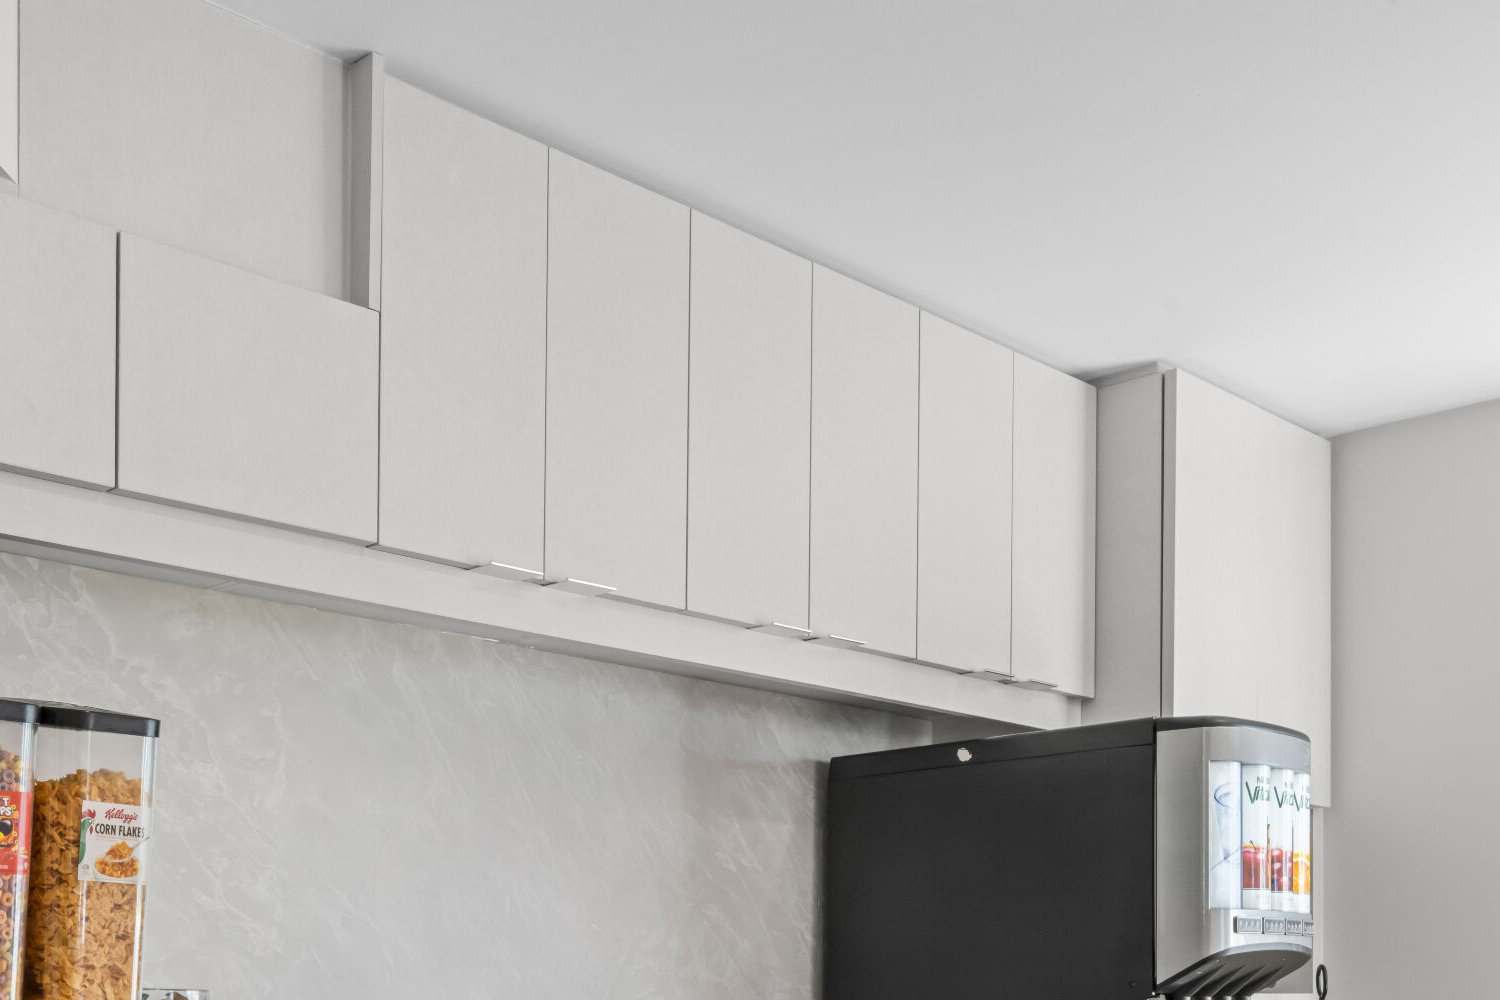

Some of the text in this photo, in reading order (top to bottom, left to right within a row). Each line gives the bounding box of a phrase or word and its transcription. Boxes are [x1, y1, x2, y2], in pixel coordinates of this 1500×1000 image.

[104, 807, 138, 824] Kellogg's
[95, 823, 117, 835] CORN
[118, 825, 146, 838] FLAKES
